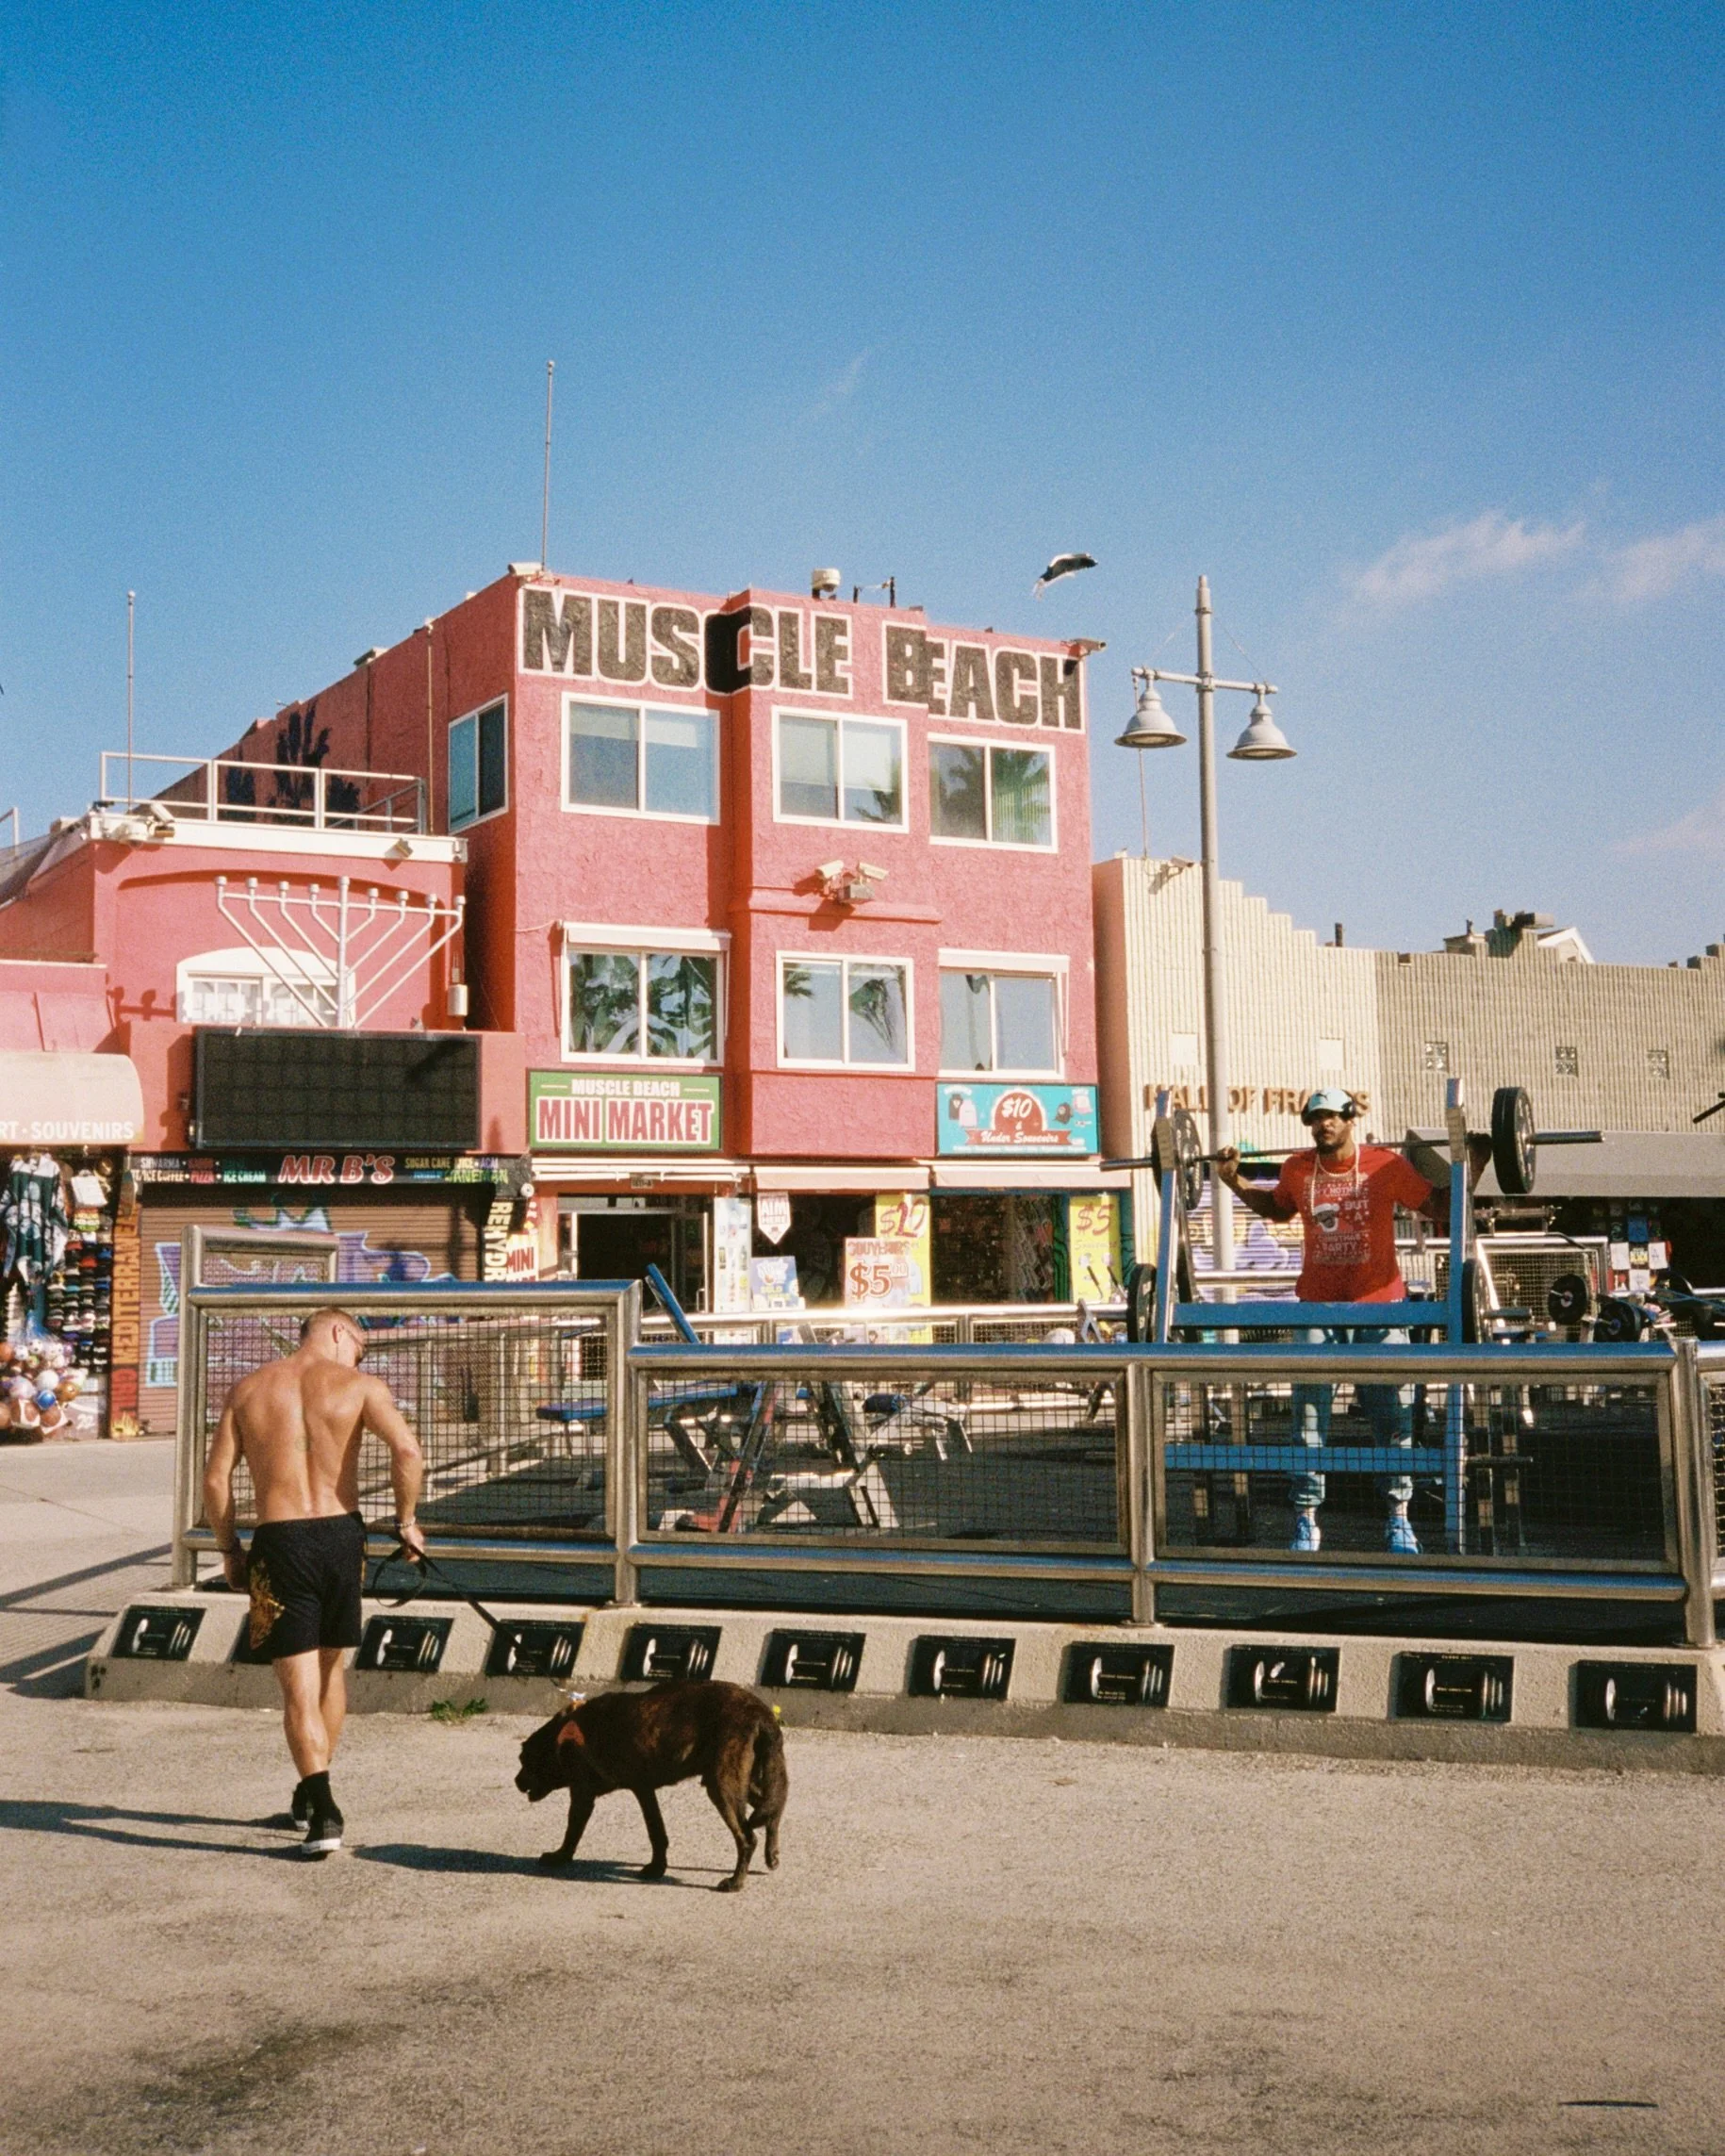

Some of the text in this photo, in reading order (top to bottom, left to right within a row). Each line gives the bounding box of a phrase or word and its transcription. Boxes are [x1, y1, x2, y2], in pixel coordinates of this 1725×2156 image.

[520, 586, 1086, 732] MUSCLE BEACH
[571, 1078, 681, 1096] MUSCLE BEACH
[1001, 1097, 1033, 1118] $10
[1228, 1087, 1257, 1112] OF
[537, 1098, 714, 1142] MINI MARKET
[31, 1121, 134, 1140] SOUVENIRS
[980, 1131, 1011, 1144] Under
[1013, 1131, 1059, 1144] Souvenirs
[278, 1154, 395, 1184] MR B'S
[405, 1158, 430, 1169] SUGAR
[432, 1158, 451, 1169] CANE
[190, 1171, 214, 1182] PIZZA
[238, 1171, 266, 1182] CREAM
[1344, 1200, 1370, 1210] BUT
[1076, 1203, 1115, 1236] $5
